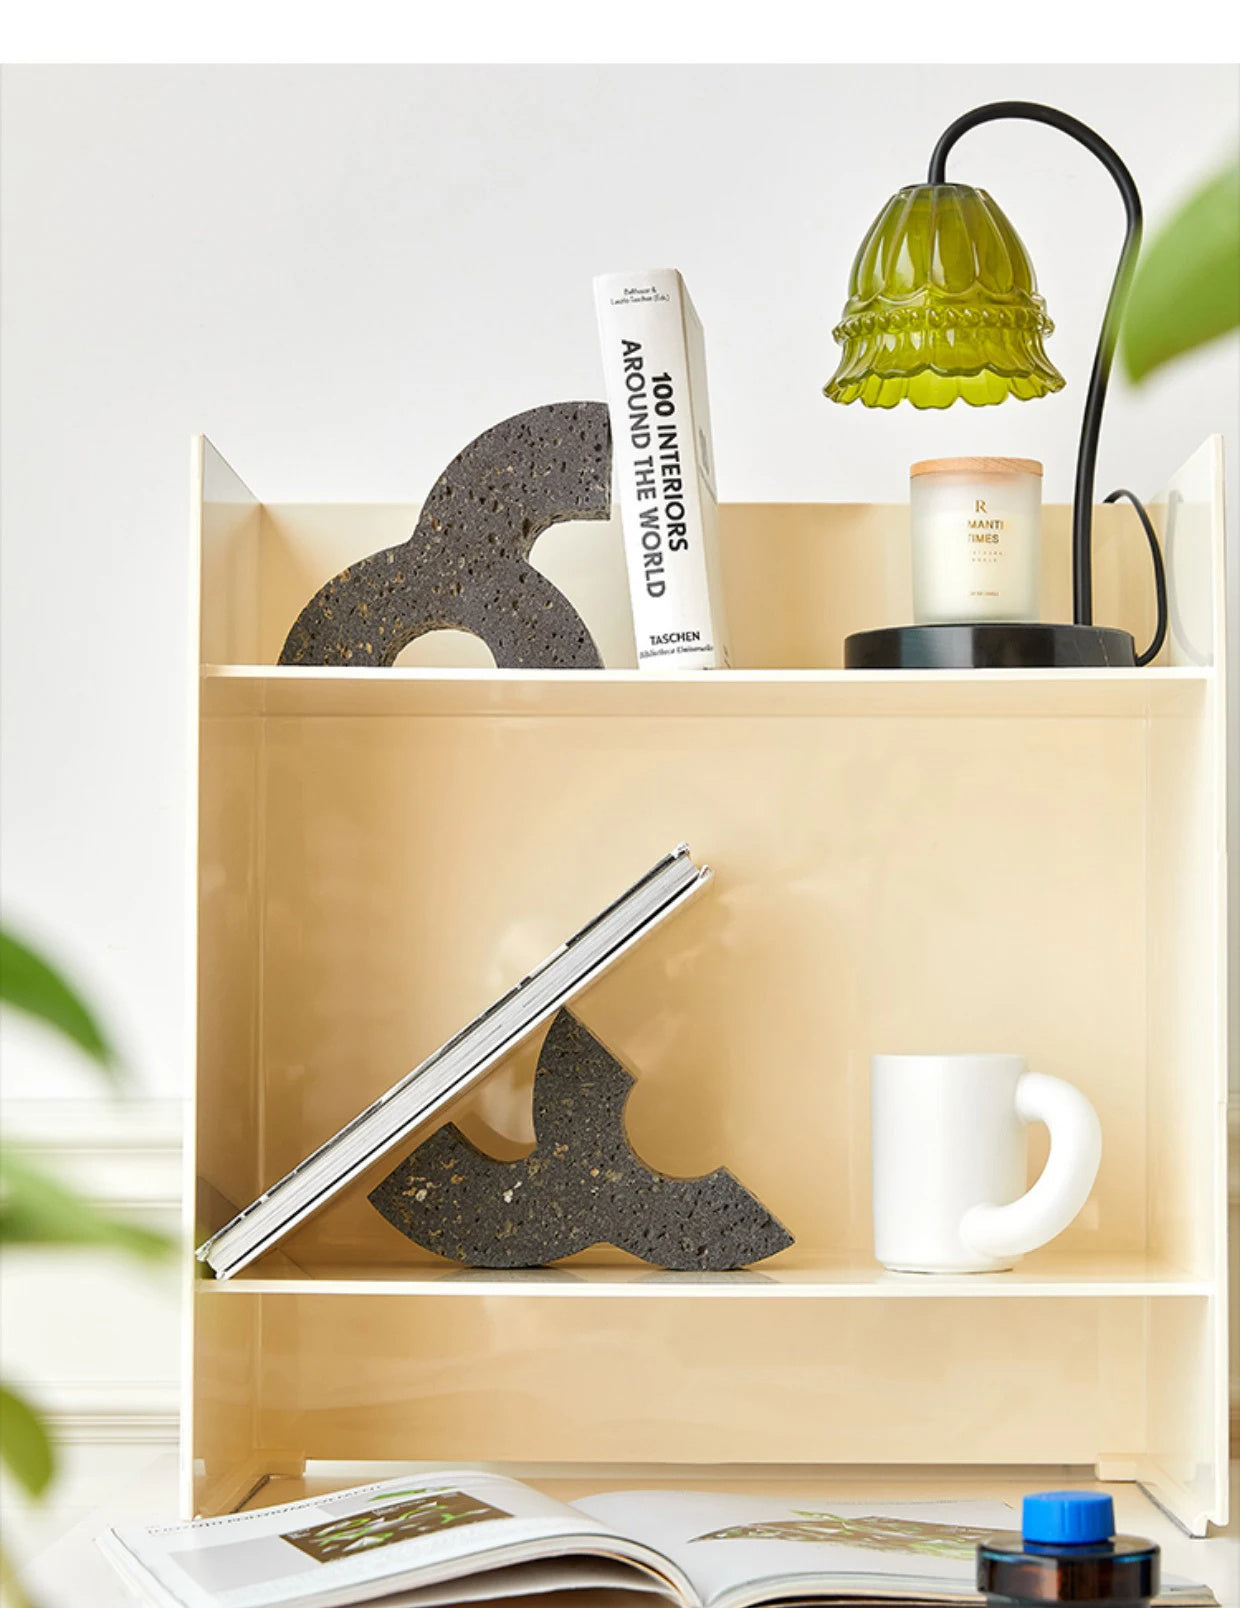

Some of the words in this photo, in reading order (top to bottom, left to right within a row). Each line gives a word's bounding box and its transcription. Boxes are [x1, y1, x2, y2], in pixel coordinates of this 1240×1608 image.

[621, 339, 651, 449] AROUND
[651, 372, 675, 417] 100
[634, 455, 657, 500] THE
[657, 424, 689, 552] INTERIORS
[975, 499, 988, 513] R
[639, 506, 666, 598] WORLD
[649, 630, 701, 645] TASCHEN
